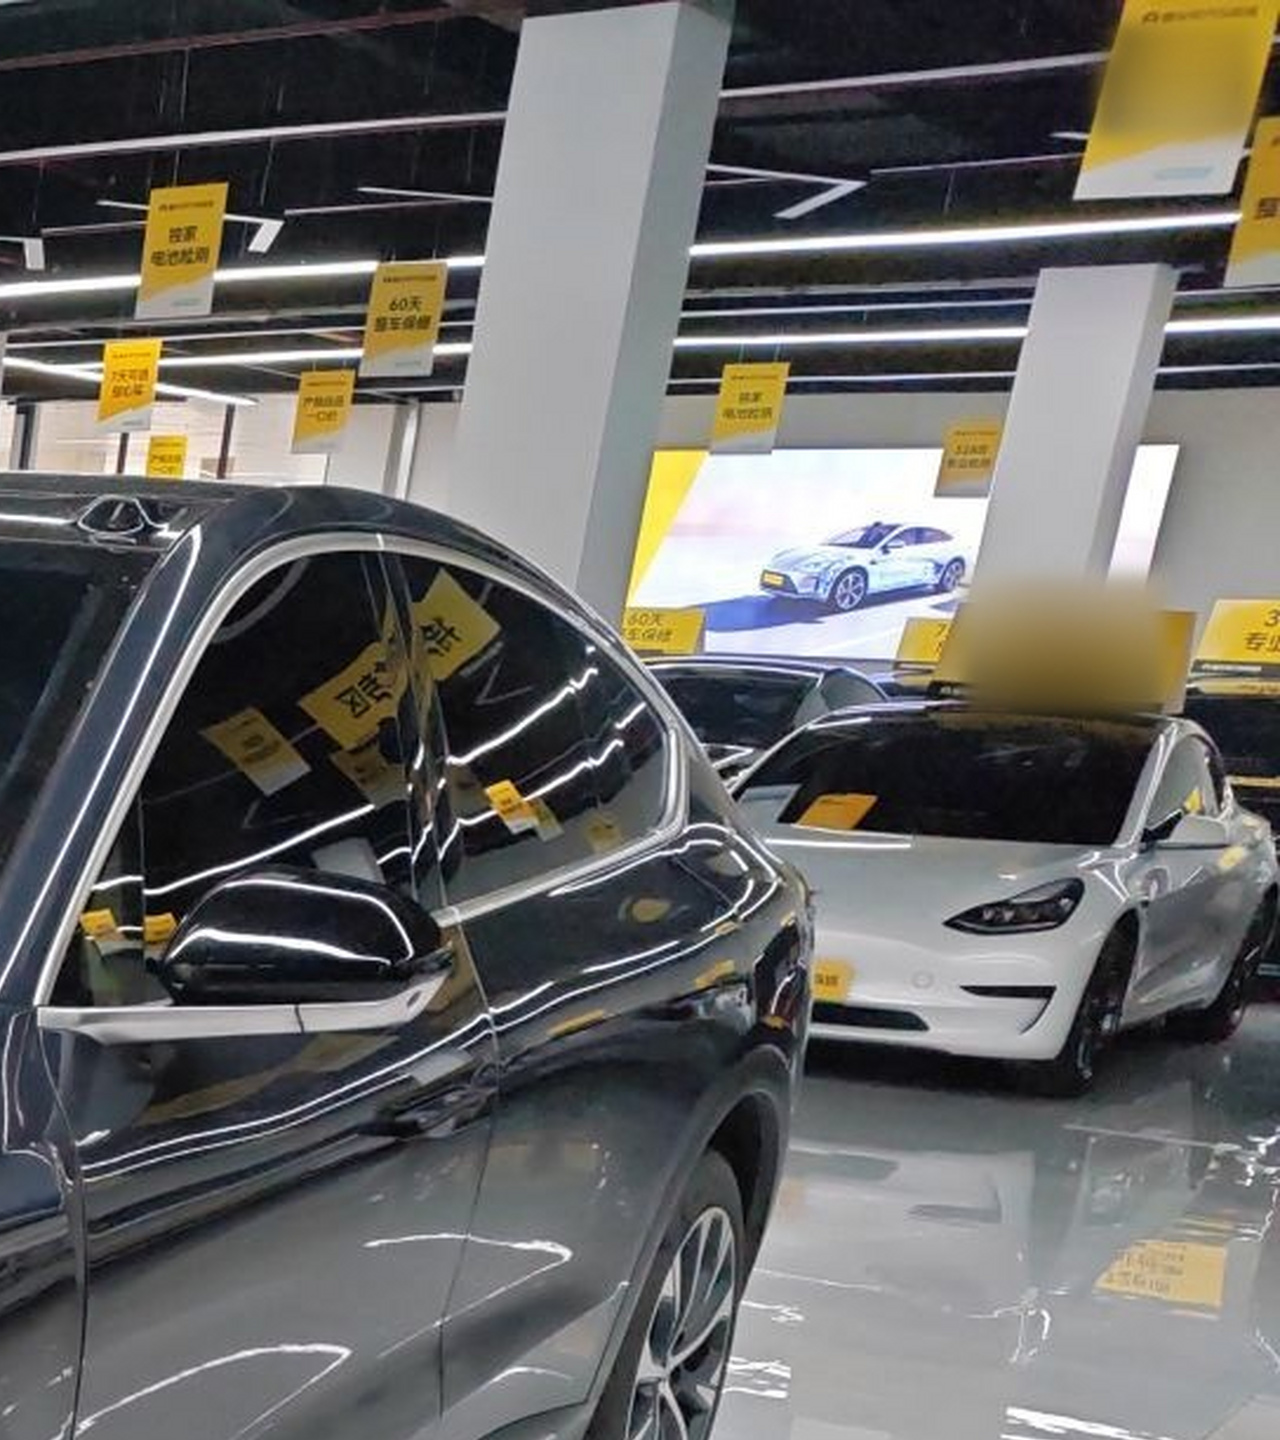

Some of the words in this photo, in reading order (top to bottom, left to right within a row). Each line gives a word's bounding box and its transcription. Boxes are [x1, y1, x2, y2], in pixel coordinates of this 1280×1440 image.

[151, 247, 210, 266] 电池检测
[389, 296, 422, 312] 60天
[374, 315, 431, 333] 整车保修
